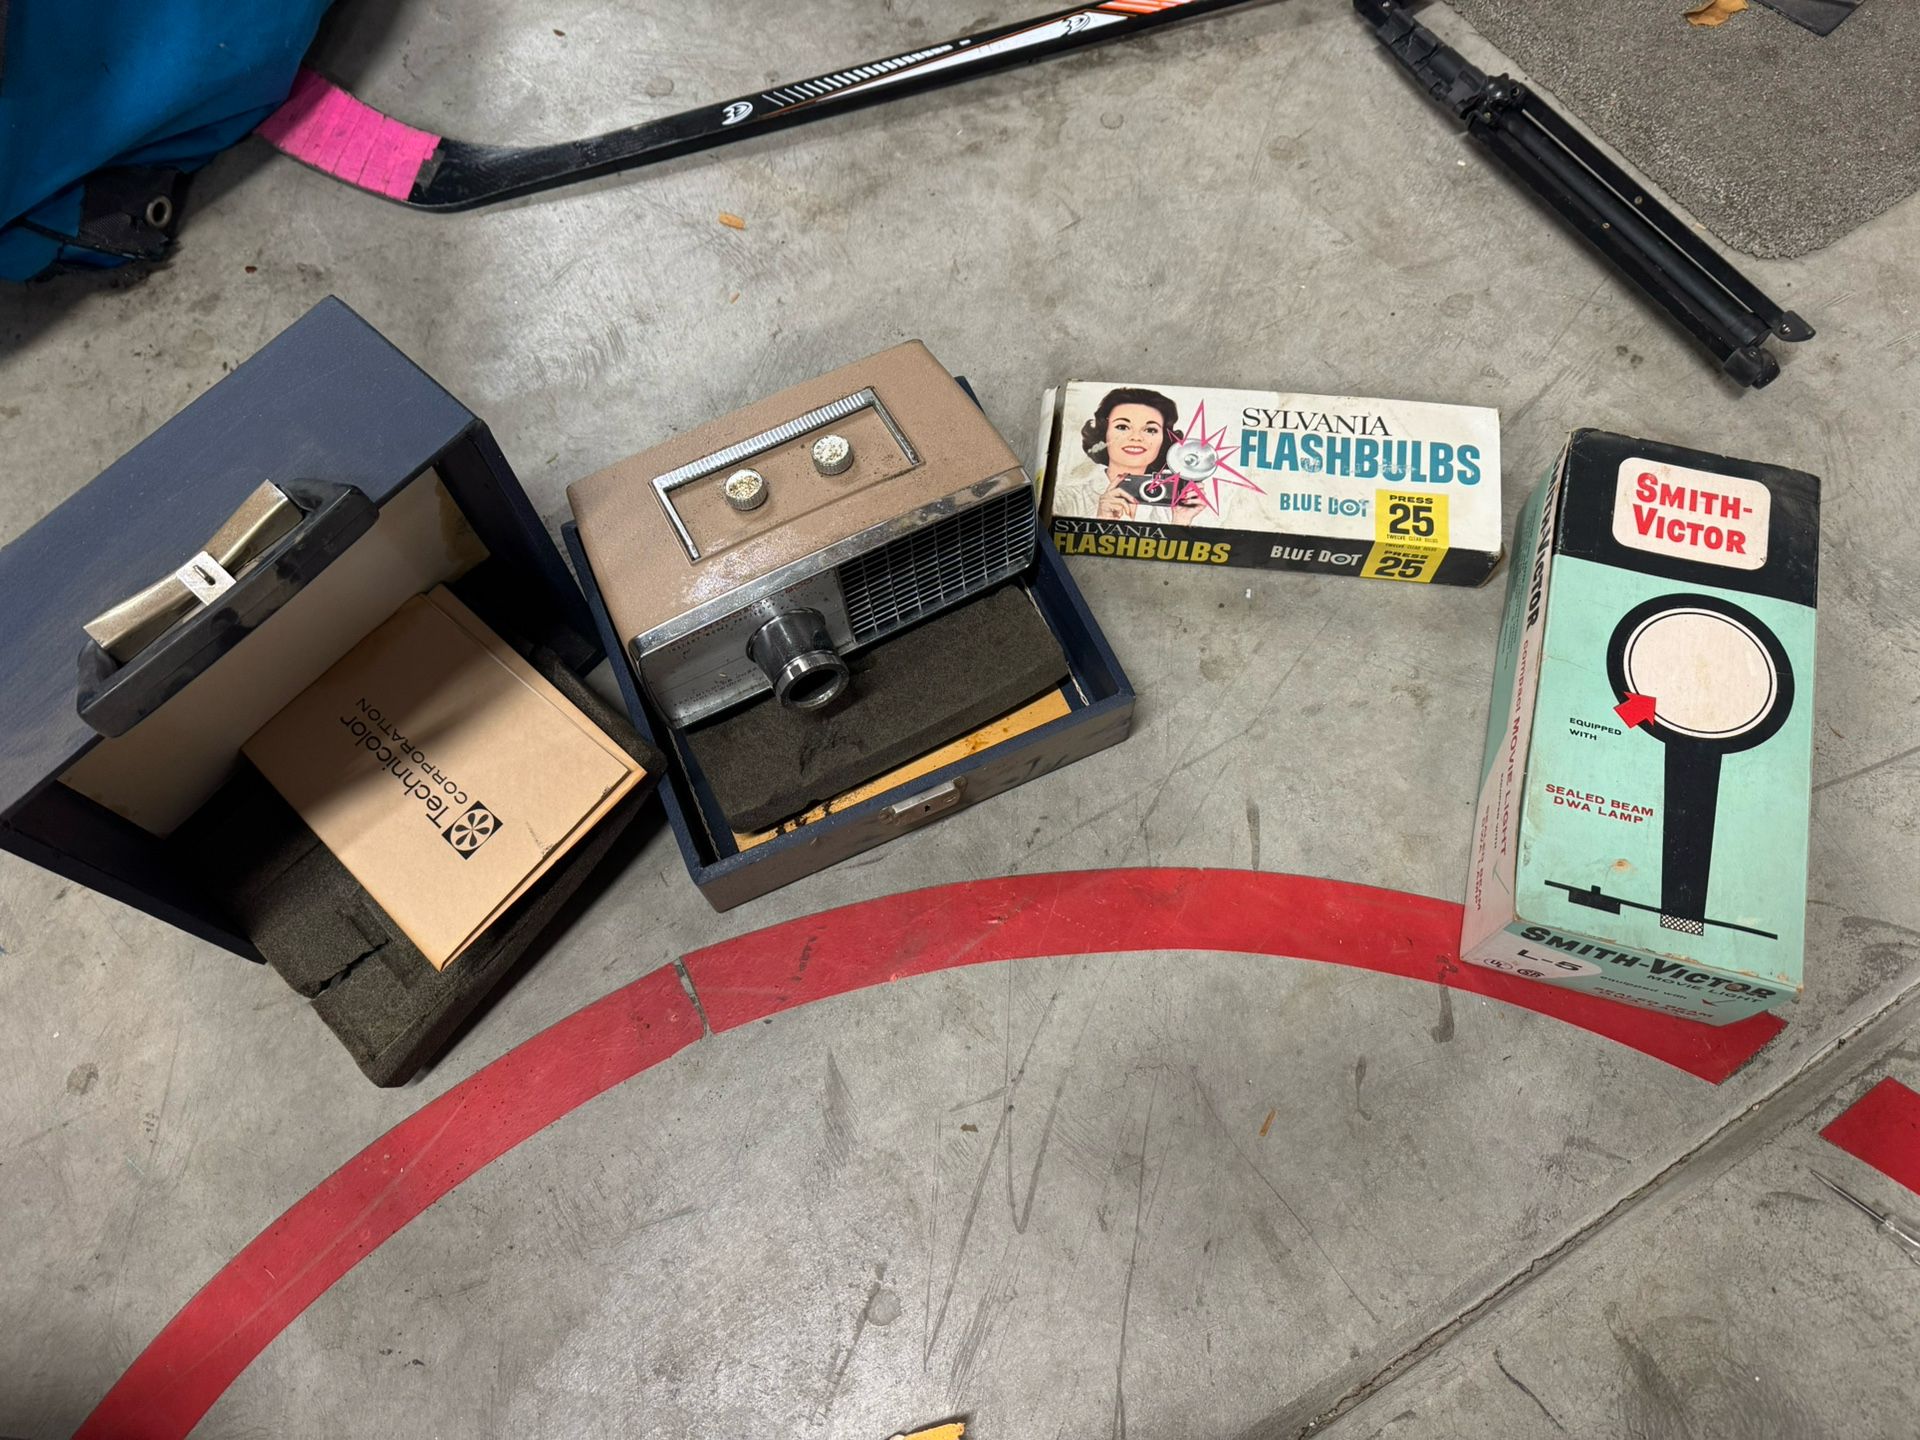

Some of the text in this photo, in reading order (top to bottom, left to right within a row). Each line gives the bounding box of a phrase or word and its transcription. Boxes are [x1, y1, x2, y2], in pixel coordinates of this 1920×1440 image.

[1242, 407, 1392, 436] SYLVANIA
[1240, 428, 1481, 485] FLASHBULBS
[1280, 493, 1370, 517] BLUE DOT
[1389, 494, 1434, 505] PRESS
[1636, 472, 1753, 520] SMITH-
[1055, 519, 1168, 539] SYLVANIA
[1389, 503, 1434, 537] 25
[1633, 503, 1746, 554] VICTOR
[1054, 531, 1232, 565] FLASHBULBS
[1270, 545, 1363, 566] BLUE DOT
[1384, 550, 1429, 560] PRESS
[1374, 556, 1426, 579] 25
[1569, 717, 1622, 736] EQUIPPED
[1569, 728, 1598, 741] WITH
[355, 697, 469, 805] CORPORATION
[340, 716, 450, 829] Technicolor
[1545, 783, 1654, 816] SEALED BEAM
[1553, 796, 1644, 823] DWA LAMP
[1517, 949, 1582, 971] L-5
[1520, 926, 1777, 1000] SMITH-VICTOR
[1647, 974, 1763, 1003] MOVIE LIGHT
